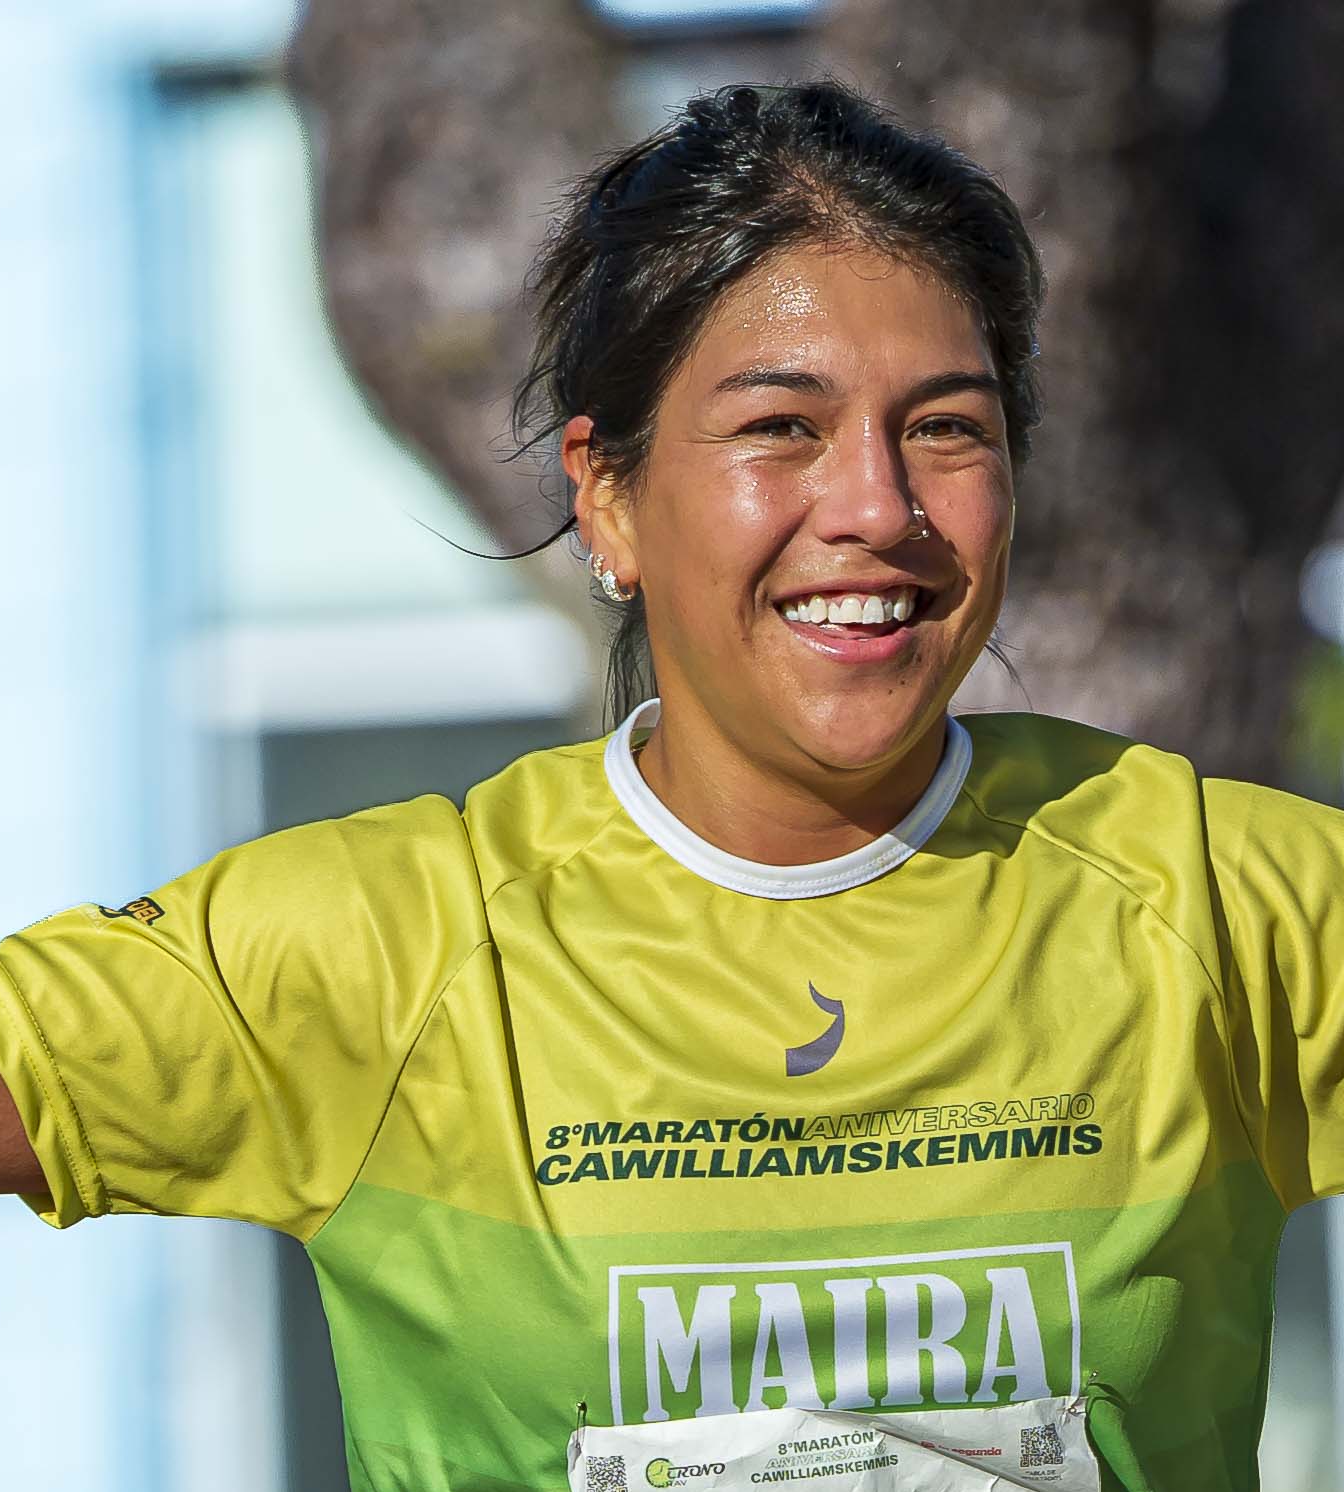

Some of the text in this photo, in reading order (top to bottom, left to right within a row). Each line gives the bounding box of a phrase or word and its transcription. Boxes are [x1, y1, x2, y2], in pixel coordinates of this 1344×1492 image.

[800, 1093, 1096, 1142] ANIVERSARIO
[535, 1123, 1103, 1186] CAWILLIAMSKEMMIS
[637, 1266, 1053, 1423] MAIRA
[750, 1454, 899, 1484] CAWILLIAMSKEMMIS
